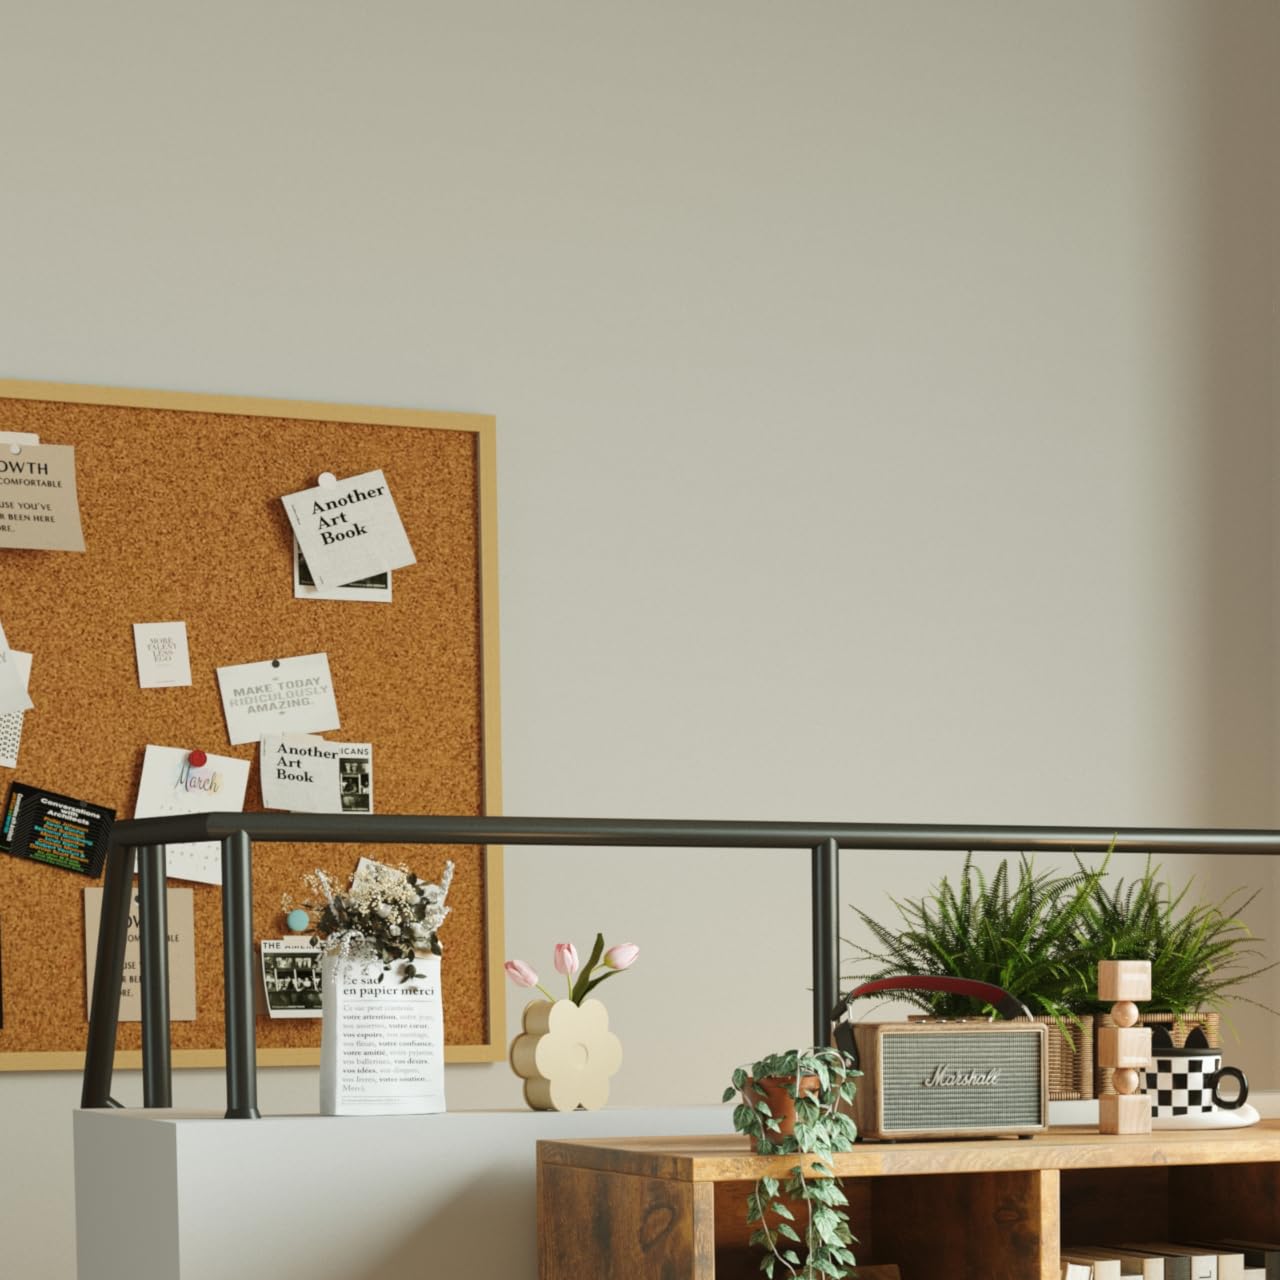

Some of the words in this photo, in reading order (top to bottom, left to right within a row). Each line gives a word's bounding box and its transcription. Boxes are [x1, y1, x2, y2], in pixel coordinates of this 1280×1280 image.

[312, 485, 385, 515] Another
[8, 513, 31, 522] BEEN
[33, 514, 56, 524] HERE
[318, 511, 348, 530] Art
[320, 523, 368, 545] Book
[229, 684, 329, 707] RIDICULOUSLY
[233, 683, 273, 697] MAKE
[276, 676, 321, 691] TODAY
[277, 743, 339, 760] Another
[276, 756, 302, 769] Art
[174, 762, 220, 793] March
[276, 768, 314, 783] Book
[263, 942, 281, 950] THE
[343, 988, 357, 996] en
[359, 986, 398, 998] papier
[401, 986, 435, 997] merci
[921, 1063, 1001, 1089] Marshall
